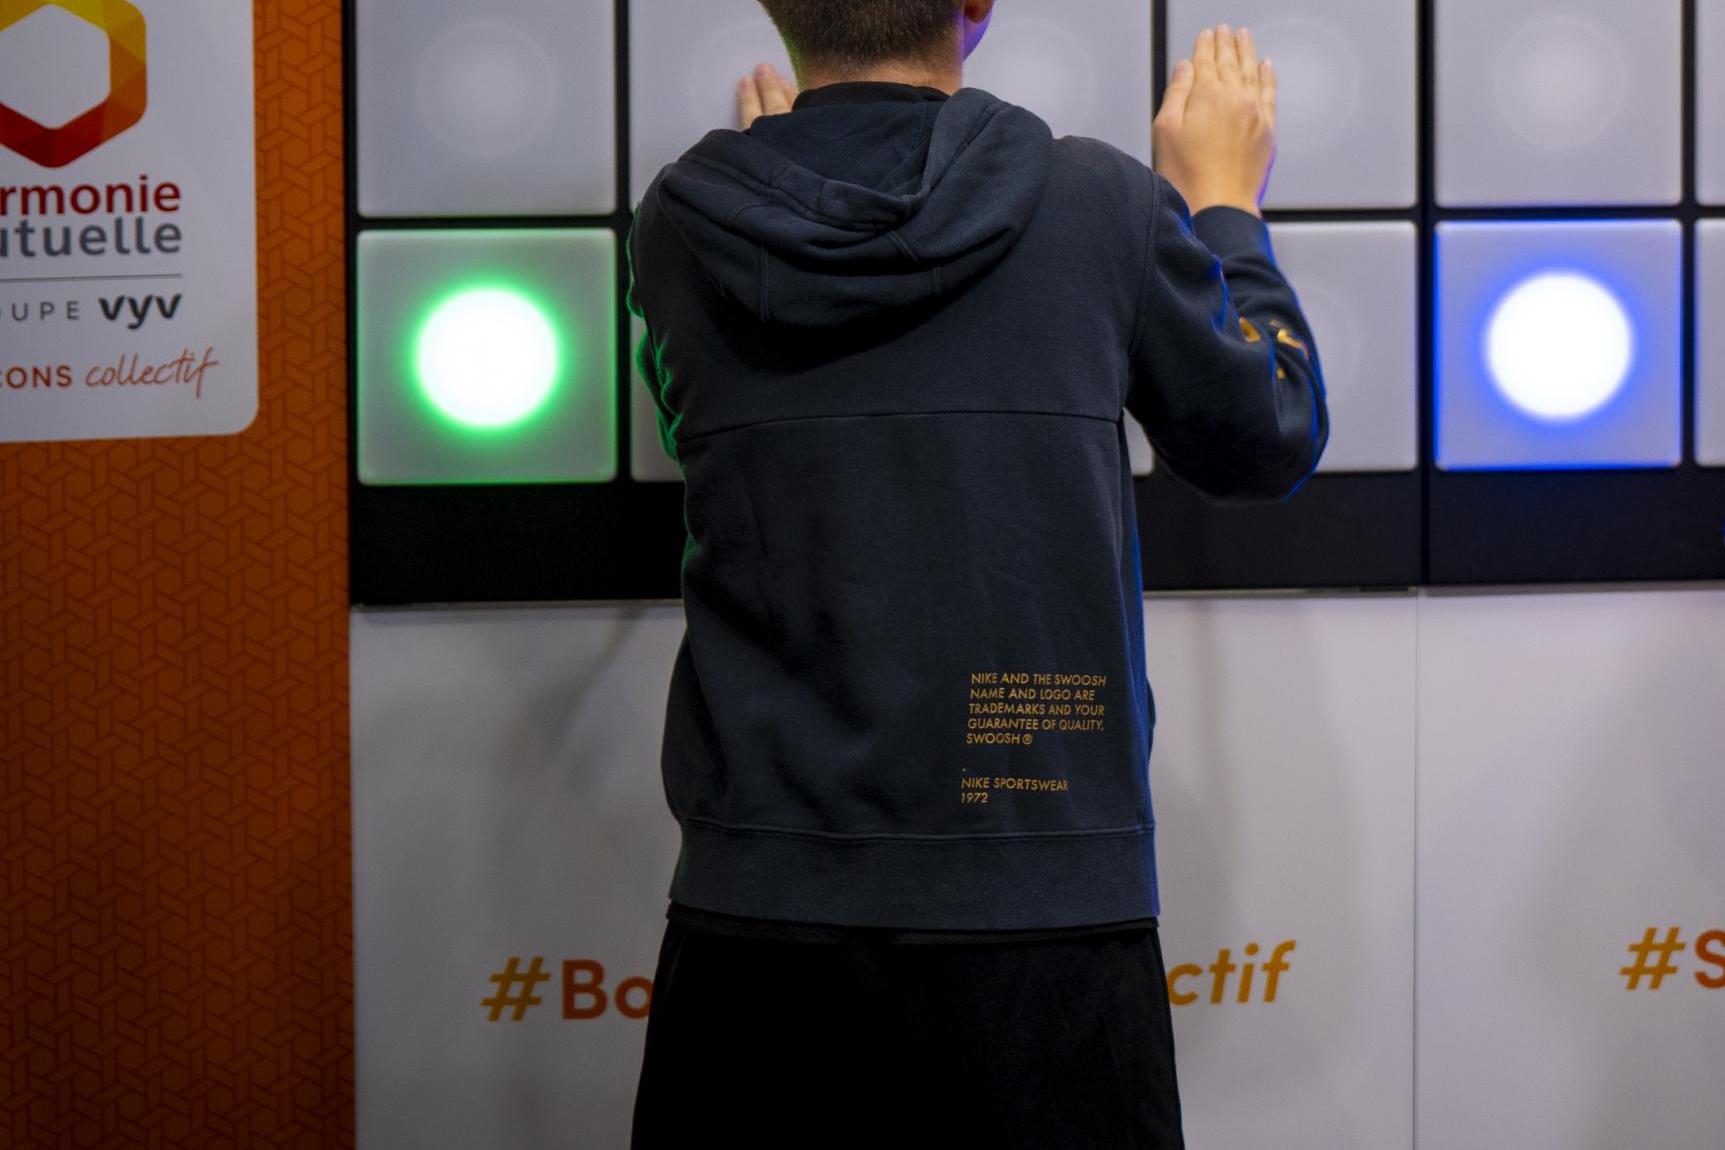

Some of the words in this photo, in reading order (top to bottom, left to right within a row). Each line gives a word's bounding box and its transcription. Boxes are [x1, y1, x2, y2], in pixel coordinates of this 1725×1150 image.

[0, 301, 79, 322] UPE
[97, 293, 182, 330] vyv
[0, 364, 73, 389] ONS
[85, 346, 219, 399] collectif
[971, 673, 998, 685] NIKE
[1001, 673, 1029, 685] AND
[1033, 673, 1052, 686] THE
[1054, 674, 1107, 687] SWOOSH
[970, 688, 1005, 699] NAME
[1008, 688, 1036, 699] AND
[1040, 689, 1071, 700] LOGO
[1074, 690, 1096, 701] ARE
[968, 702, 1046, 715] TRADEMARKS
[1048, 704, 1072, 715] AND
[1074, 705, 1105, 716] YOUR
[968, 718, 1039, 730] GUARANTEE
[1042, 719, 1058, 730] OF
[1059, 719, 1105, 731] QUALITY.
[961, 777, 990, 789] NIKE
[993, 777, 1069, 791] SPORTSWEAR
[960, 792, 989, 804] 1972
